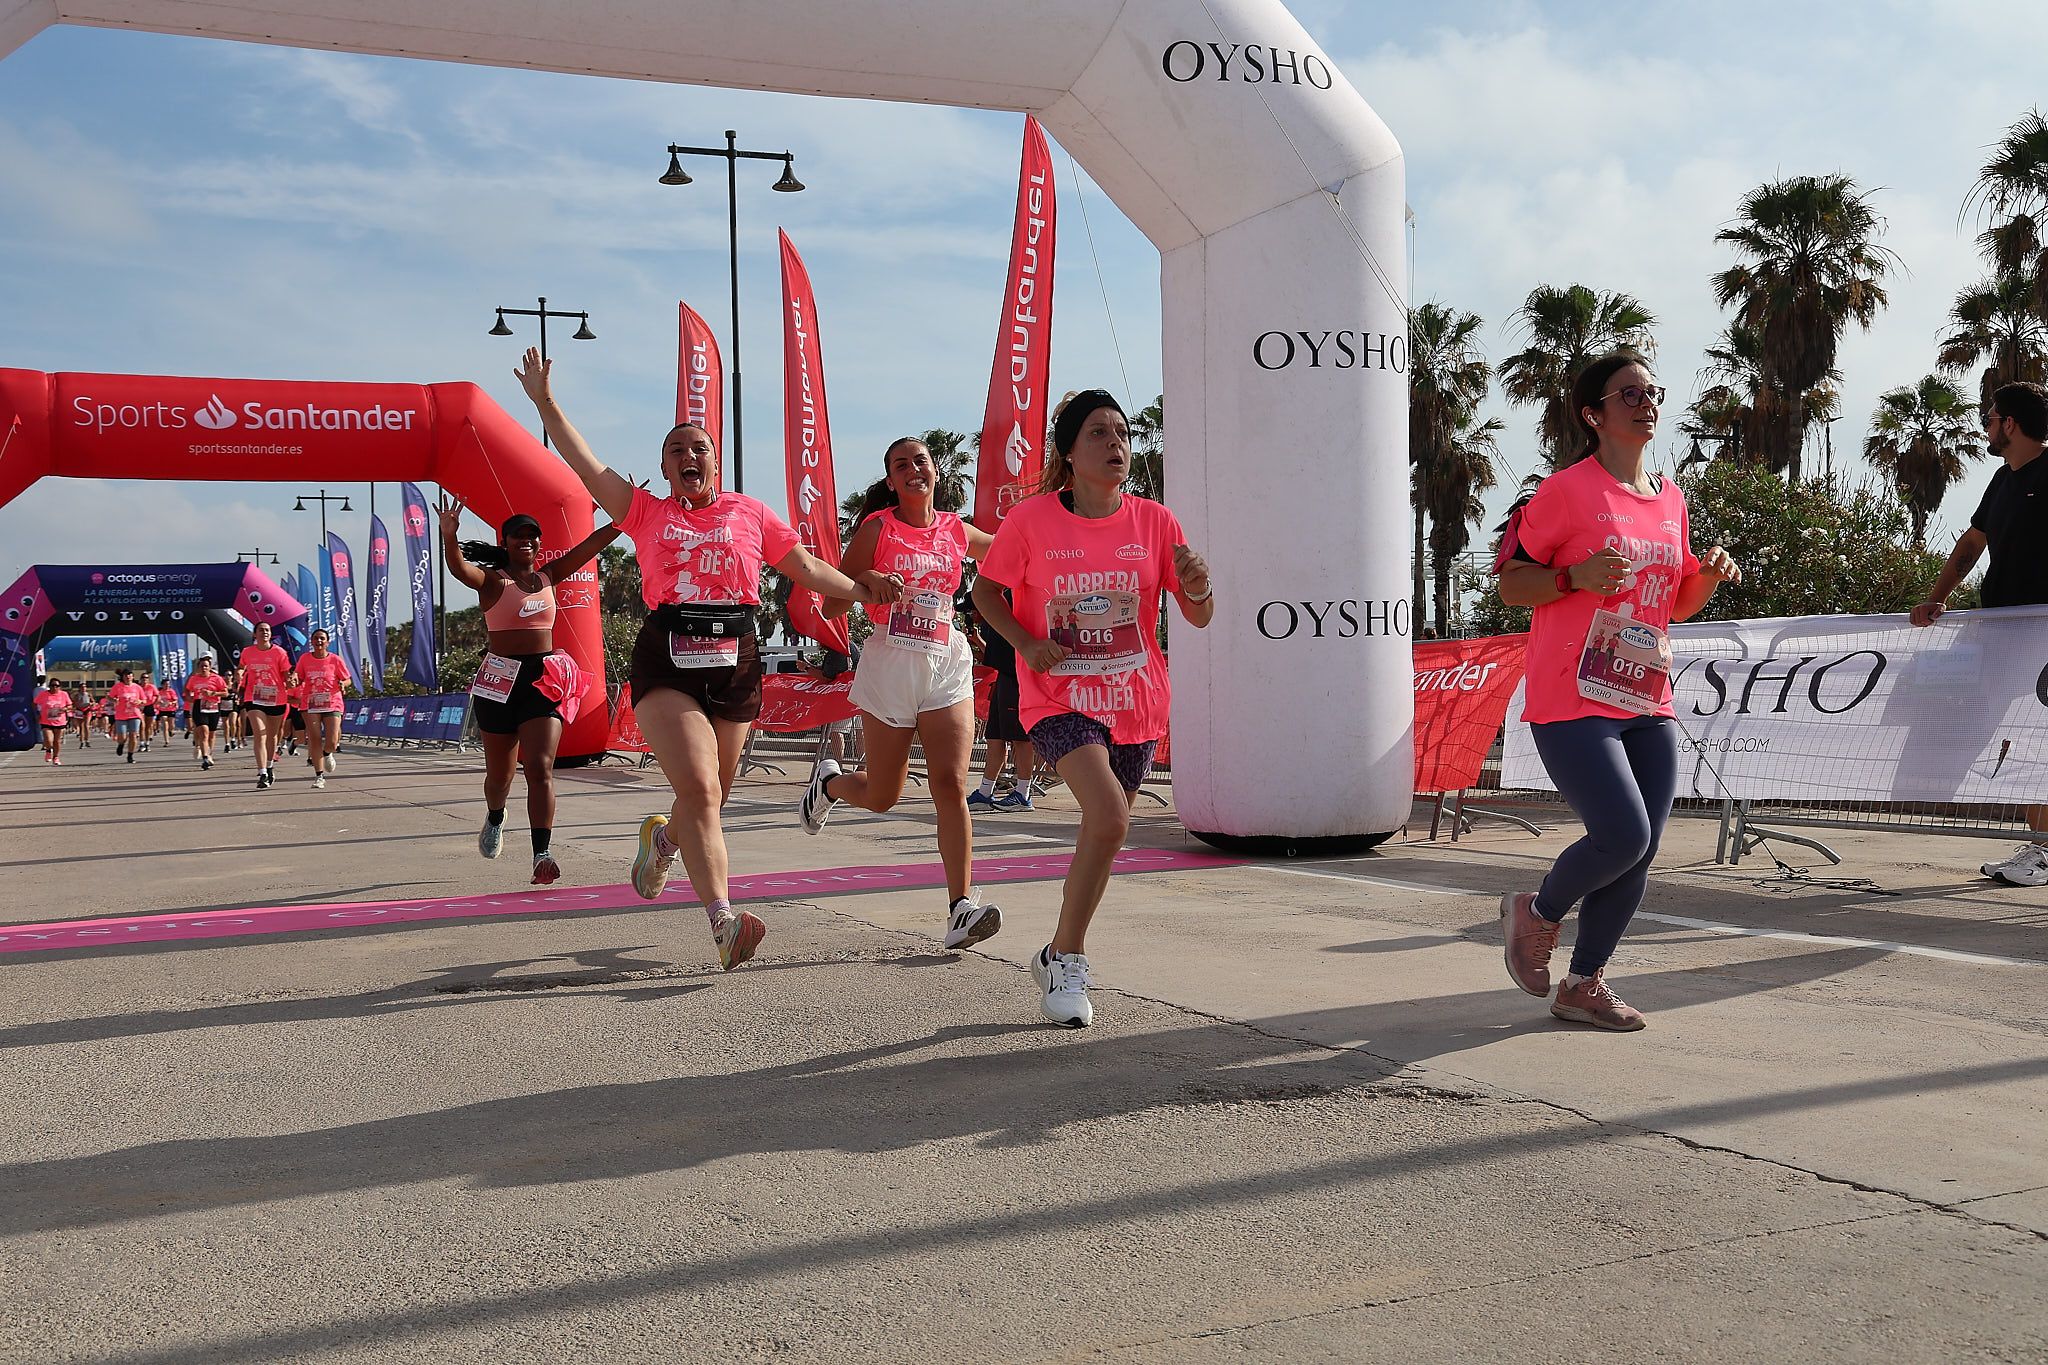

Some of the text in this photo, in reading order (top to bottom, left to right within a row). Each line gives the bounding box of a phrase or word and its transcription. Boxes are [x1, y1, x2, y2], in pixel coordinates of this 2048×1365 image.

[1162, 40, 1332, 90] OYSHO
[1253, 330, 1406, 373] OYSHO
[73, 397, 415, 434] Sports Santander
[188, 443, 303, 455] sportssantander.es
[1597, 512, 1634, 525] OYSHO
[700, 548, 722, 576] DE
[895, 553, 954, 572] CARRERA
[1045, 549, 1085, 561] OYSHO
[107, 574, 197, 585] octopus energy
[1054, 570, 1140, 596] CARRERA
[165, 588, 202, 596] CORRER
[524, 600, 545, 610] NIKE
[66, 610, 185, 622] VOLVO
[912, 616, 937, 631] 016
[1256, 598, 1410, 640] OYSHO
[1080, 628, 1114, 644] 016
[1060, 663, 1091, 671] OYSHO
[1108, 660, 1136, 670] Santander
[1613, 658, 1646, 680] 016
[484, 672, 500, 684] 016
[1413, 660, 1498, 691] ander
[1070, 685, 1135, 712] MUJER
[1584, 685, 1612, 699] OYSHO
